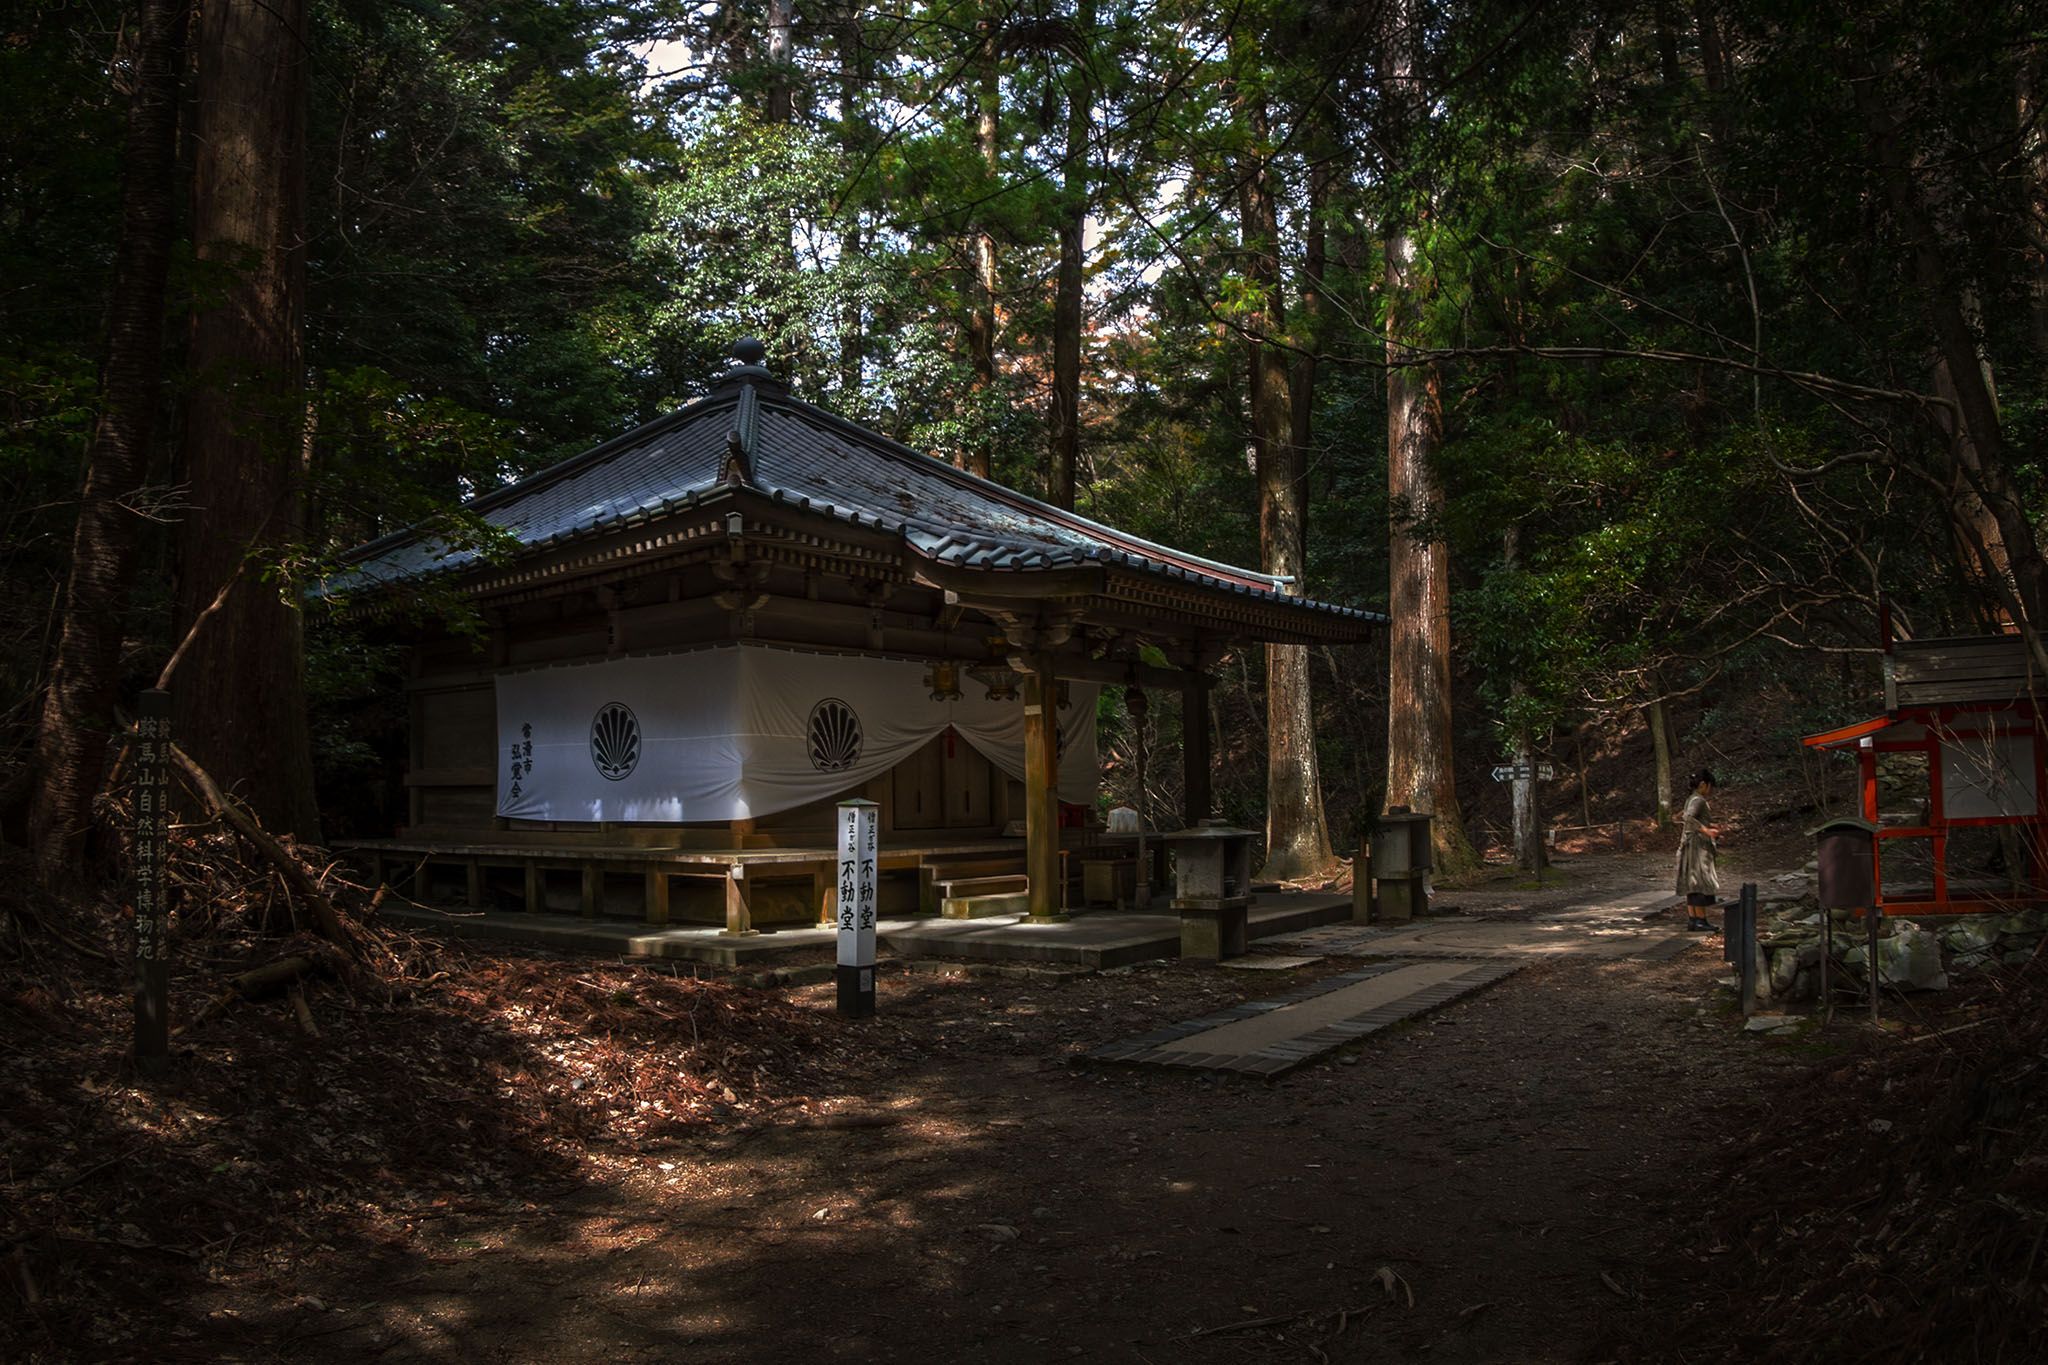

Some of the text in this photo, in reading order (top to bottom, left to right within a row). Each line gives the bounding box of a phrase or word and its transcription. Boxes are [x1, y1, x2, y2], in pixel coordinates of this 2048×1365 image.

[840, 860, 855, 931] 不動堂
[860, 859, 874, 930] 不動堂
